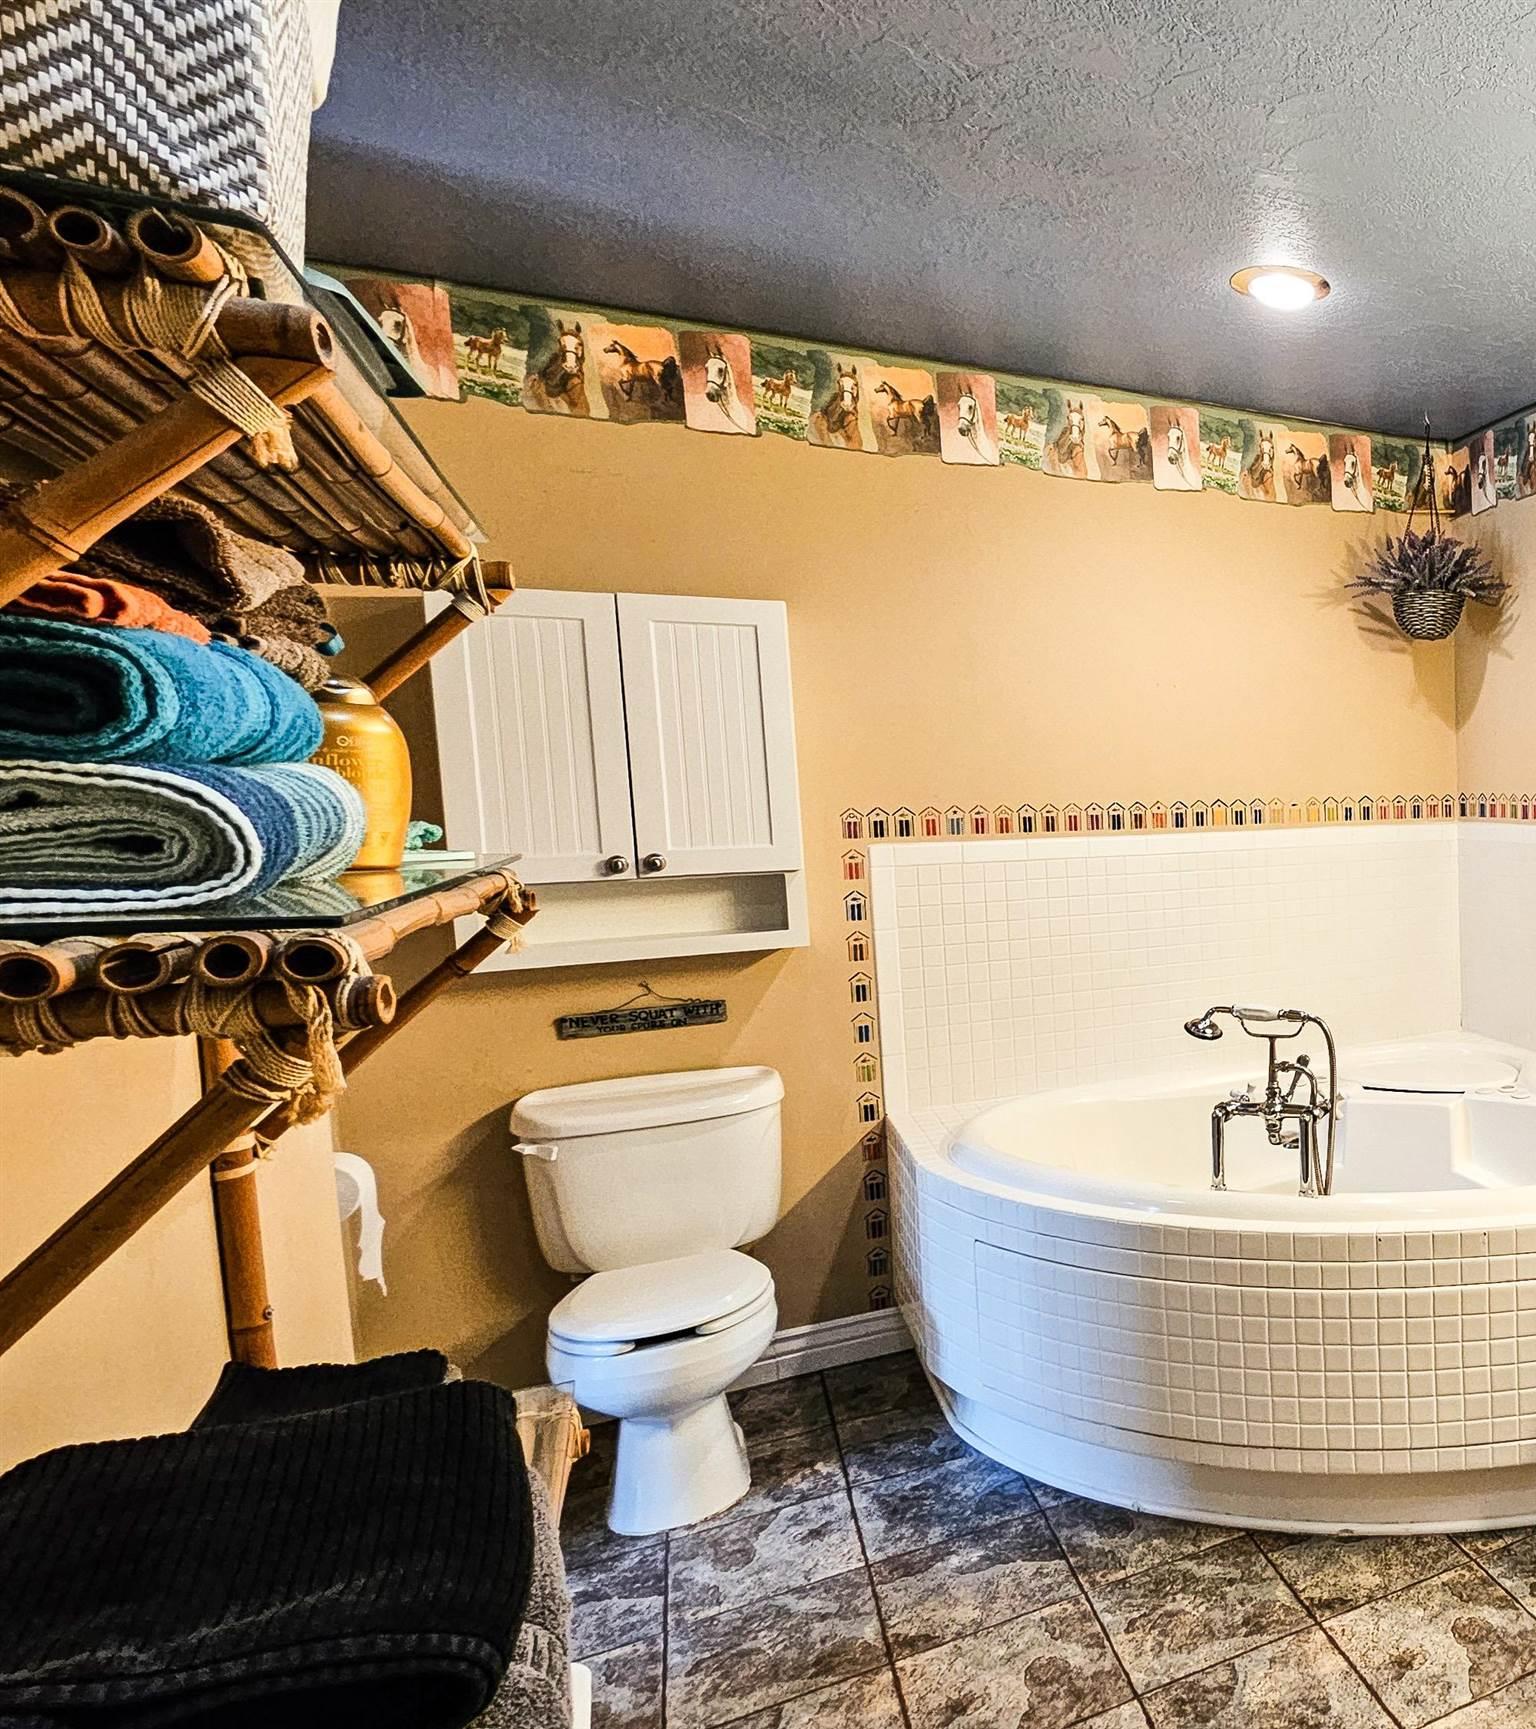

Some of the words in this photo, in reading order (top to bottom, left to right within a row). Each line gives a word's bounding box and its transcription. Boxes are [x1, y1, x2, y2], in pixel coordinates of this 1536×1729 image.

[569, 1013, 619, 1029] NEVER
[628, 1007, 678, 1022] SQUAT
[683, 1002, 722, 1016] WITH
[597, 1024, 626, 1033] YOUR
[671, 1017, 688, 1027] ON
